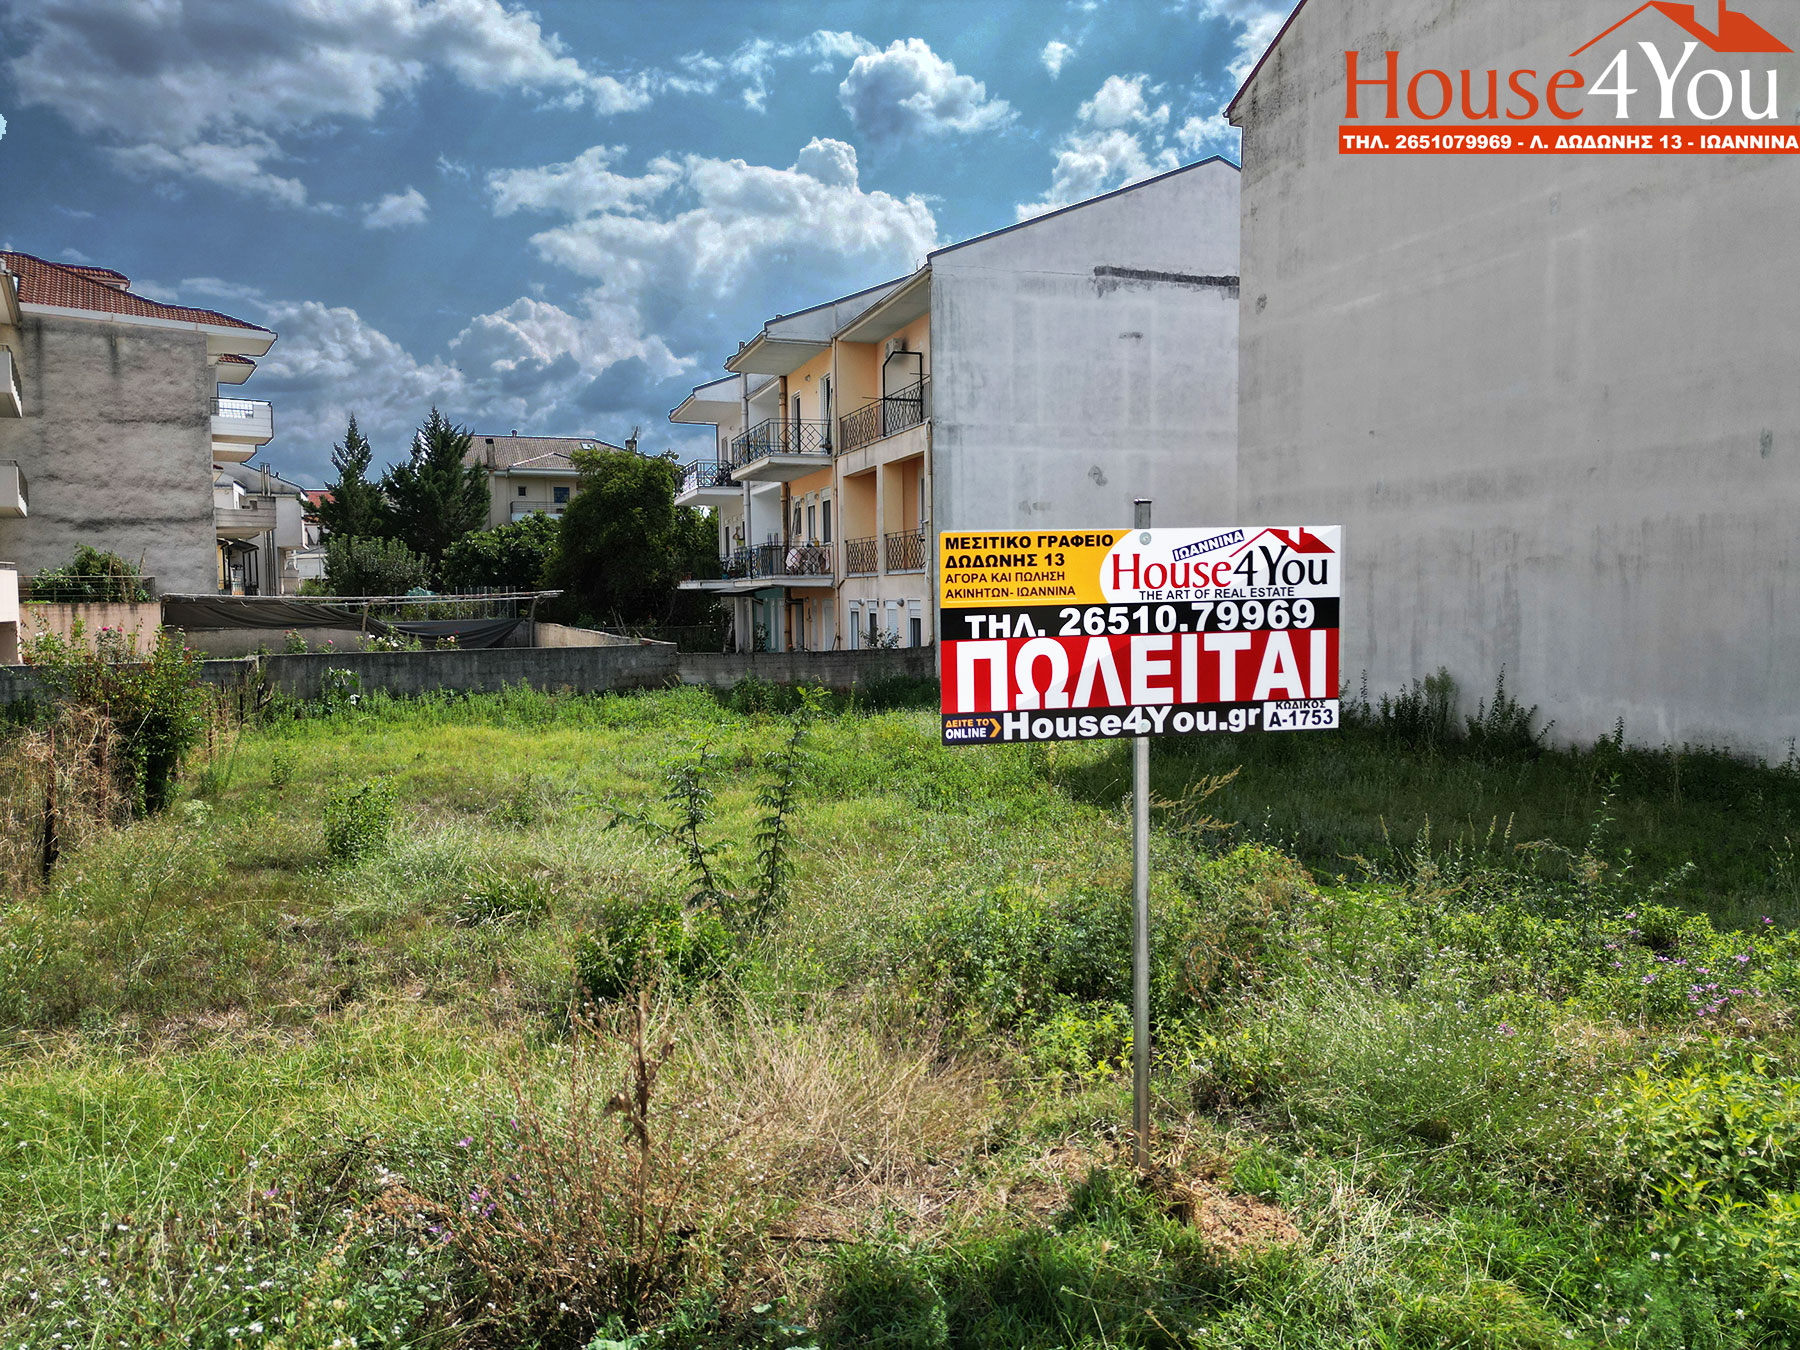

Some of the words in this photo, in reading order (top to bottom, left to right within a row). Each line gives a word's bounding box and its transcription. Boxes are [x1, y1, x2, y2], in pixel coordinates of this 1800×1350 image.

[945, 536, 1031, 550] ΜΕΣΙΤΙΚΟ
[1037, 534, 1113, 548] ΓΡΑΦΕΙΟ
[1174, 530, 1244, 561] ΙΩΑΝΝΙΝΑ
[945, 554, 1037, 568] ΔΩΔΩΝΗΣ
[1044, 553, 1065, 567] 13
[1112, 545, 1328, 590] House4You
[945, 573, 987, 584] ΑΓΟΡΑ
[991, 572, 1011, 582] ΚΑΙ
[1015, 571, 1065, 582] ΠΩΛΗΣΗ
[1017, 586, 1076, 597] ΙΩΑΝΝΙΝΑ
[1139, 590, 1163, 600] THE
[1166, 589, 1191, 600] ART
[1195, 589, 1211, 599] OF
[1214, 588, 1246, 599] REAL
[1250, 587, 1295, 598] ESTATE
[965, 614, 1046, 639] ΤΗΛ.
[1058, 599, 1315, 637] 26510.79969
[956, 629, 1327, 713] ΠΩΛΕΙΤΑΙ
[1275, 700, 1326, 710] ΚΩΔΙΚΟΣ
[945, 718, 973, 728] ΔΕΙΤΕ
[977, 718, 989, 726] ΤΟ
[1003, 706, 1261, 741] House4You.gr
[1269, 709, 1333, 727] A-1753
[945, 728, 986, 739] ONLINE
